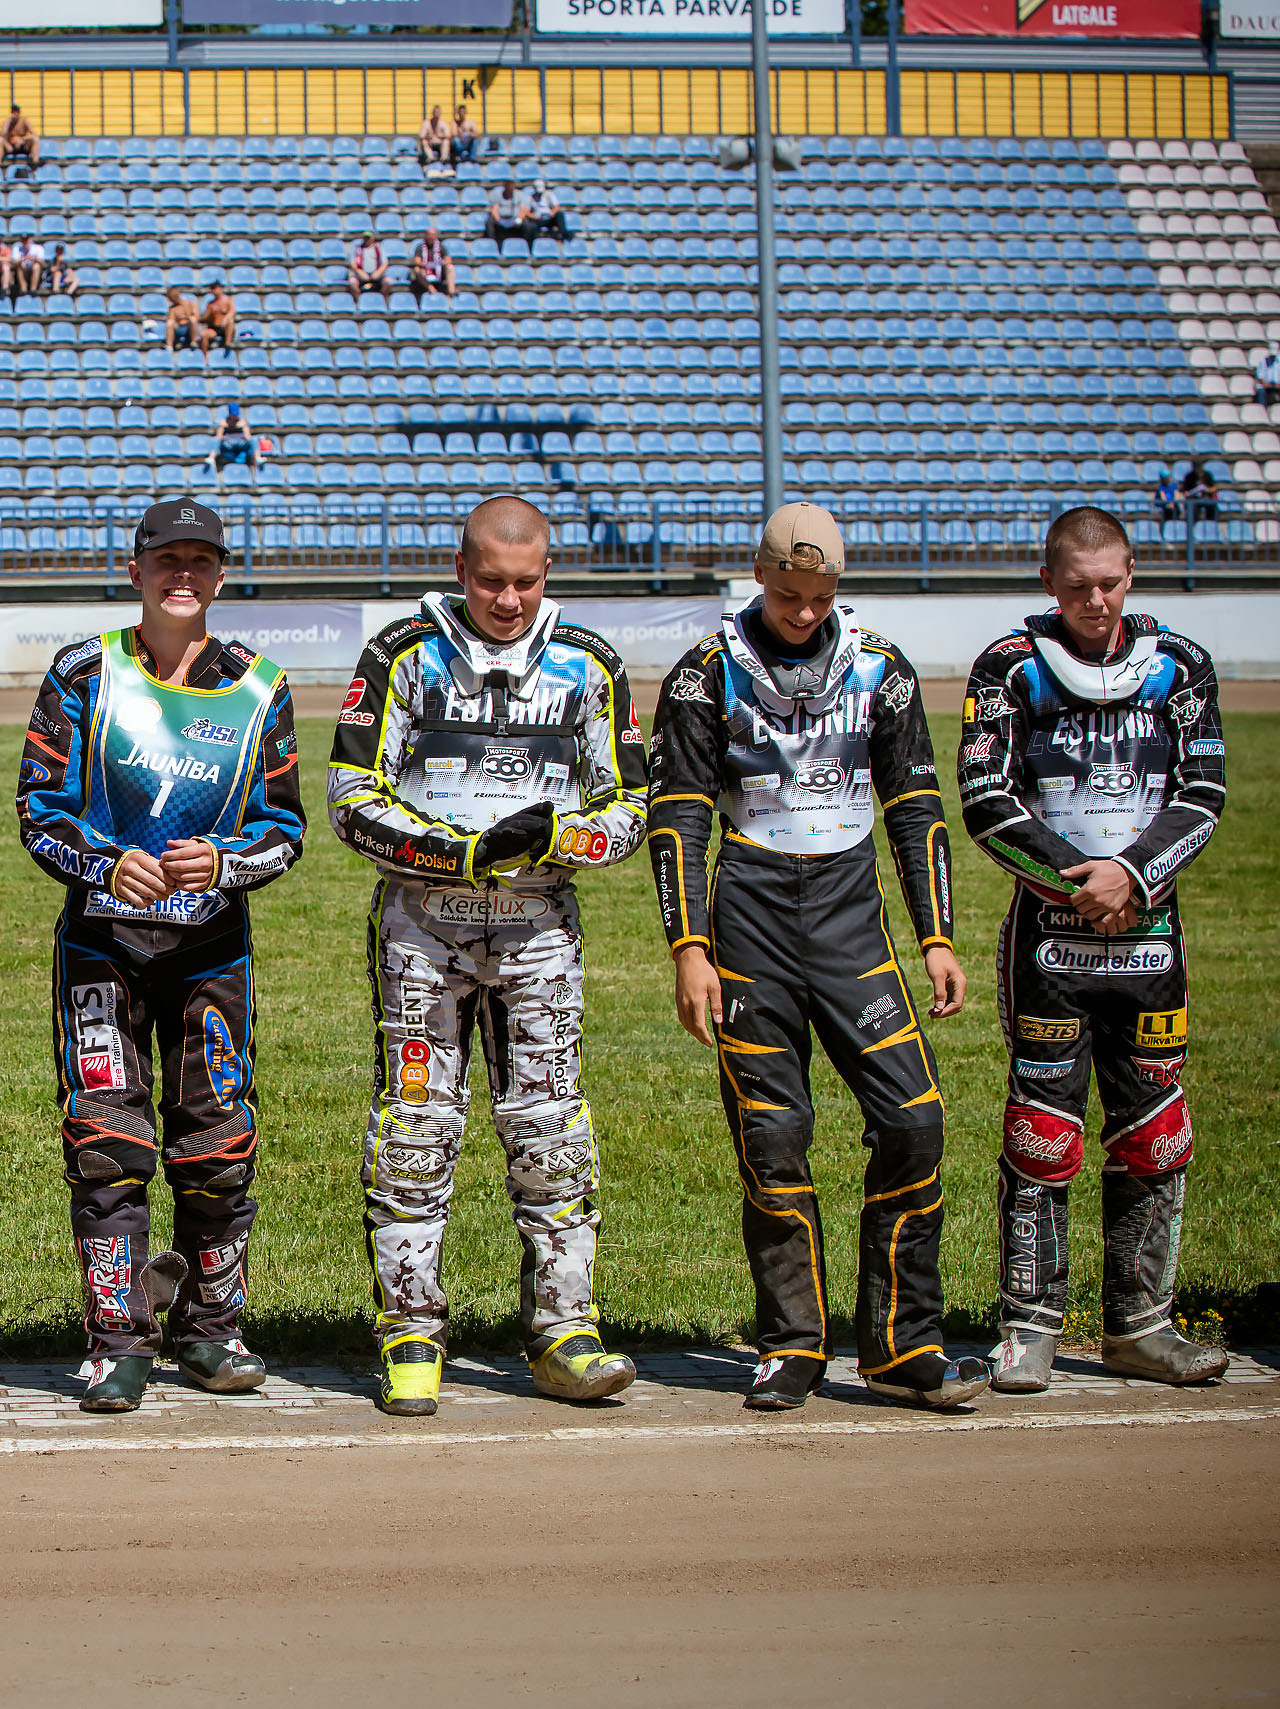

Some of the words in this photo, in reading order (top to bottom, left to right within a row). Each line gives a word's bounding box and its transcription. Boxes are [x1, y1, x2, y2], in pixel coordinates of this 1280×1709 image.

[568, 0, 665, 16] SPORTA
[675, 0, 803, 16] PARVADE
[1052, 5, 1117, 26] LATGALE
[462, 79, 475, 100] K
[118, 741, 221, 785] JAUNĪBA
[489, 748, 526, 756] MOTOSPORT
[485, 756, 528, 777] 360
[801, 760, 837, 769] MOTOSPORT
[798, 768, 841, 788] 360
[1092, 773, 1134, 794] 360
[150, 779, 174, 818] 1
[354, 829, 395, 858] Briketi
[414, 853, 458, 872] poisid
[561, 829, 605, 857] ABC
[609, 829, 643, 859] RENT
[24, 830, 81, 875] TEAM
[82, 854, 115, 886] TK
[659, 850, 673, 928] Europlaster
[86, 906, 153, 920] ENGINEERING
[155, 911, 177, 922] (NE)
[180, 913, 198, 922] LTD
[440, 894, 526, 917] Kerelux
[1050, 912, 1085, 927] KMT
[1043, 943, 1169, 970] Õhumeister
[73, 986, 109, 1056] FTS
[404, 984, 424, 1037] RENT
[554, 1009, 572, 1047] Abc
[1142, 1012, 1179, 1035] LT
[110, 1028, 124, 1067] Training
[209, 1015, 224, 1073] Catering
[115, 1068, 125, 1087] Fire
[403, 1045, 426, 1102] ABC
[389, 1167, 443, 1182] design
[545, 1161, 590, 1182] design
[118, 1262, 126, 1290] DURHAM
